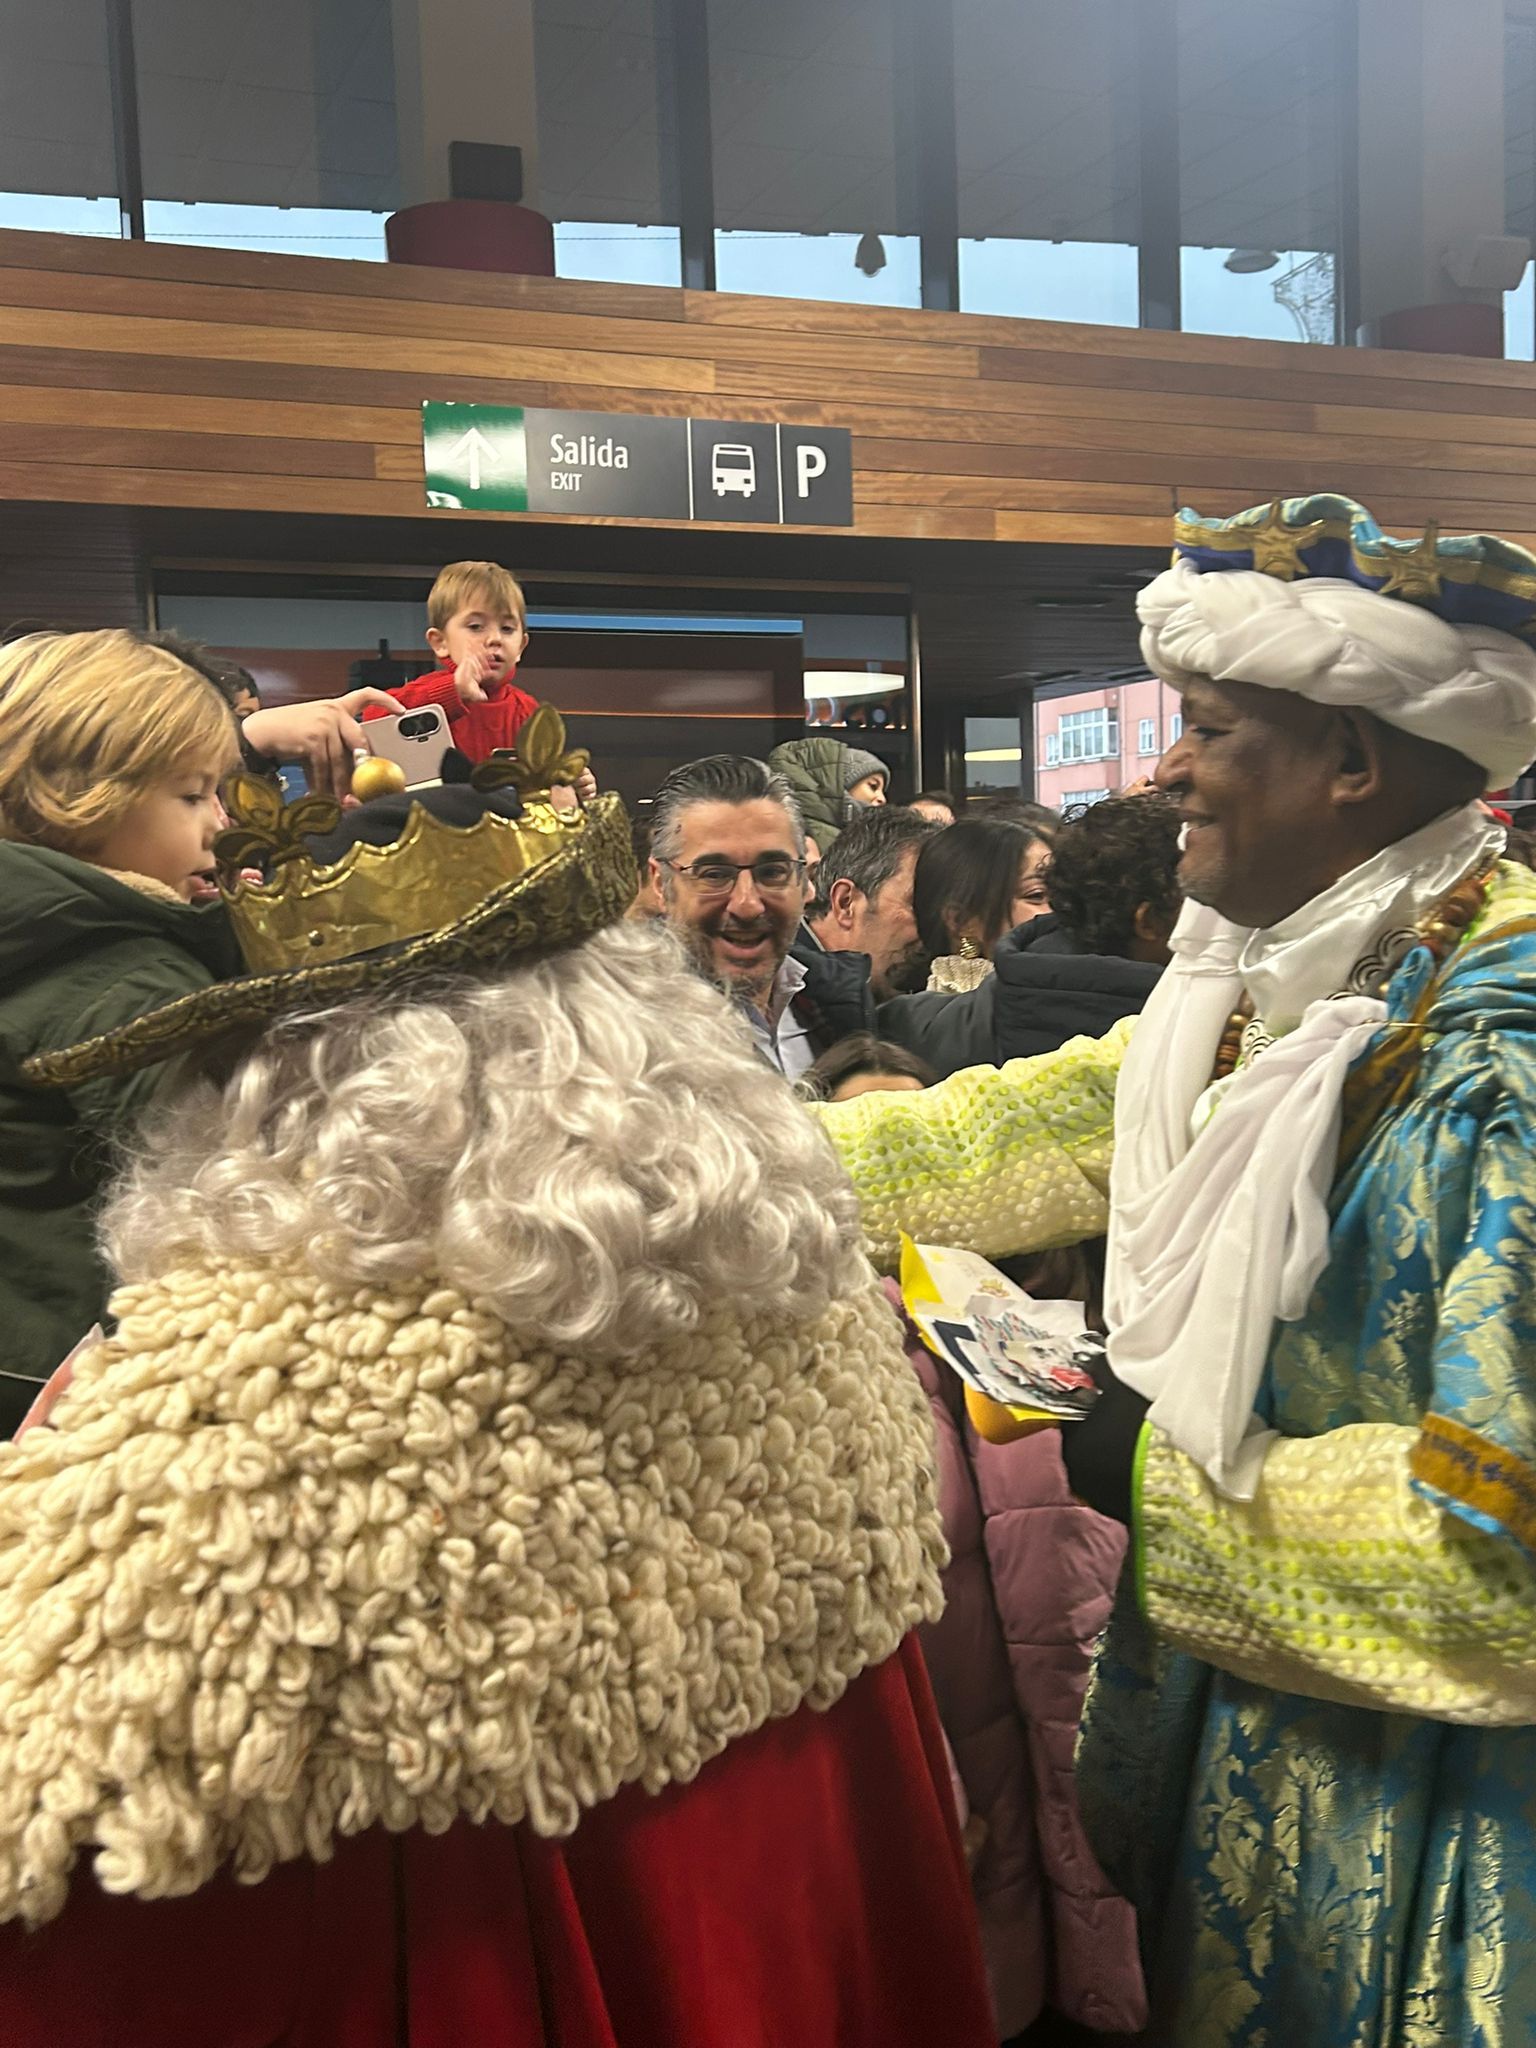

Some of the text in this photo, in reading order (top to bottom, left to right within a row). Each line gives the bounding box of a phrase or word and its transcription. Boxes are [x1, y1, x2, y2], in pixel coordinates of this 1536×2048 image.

[550, 433, 629, 469] Salida
[550, 471, 583, 492] EXIT
[796, 445, 827, 498] P
